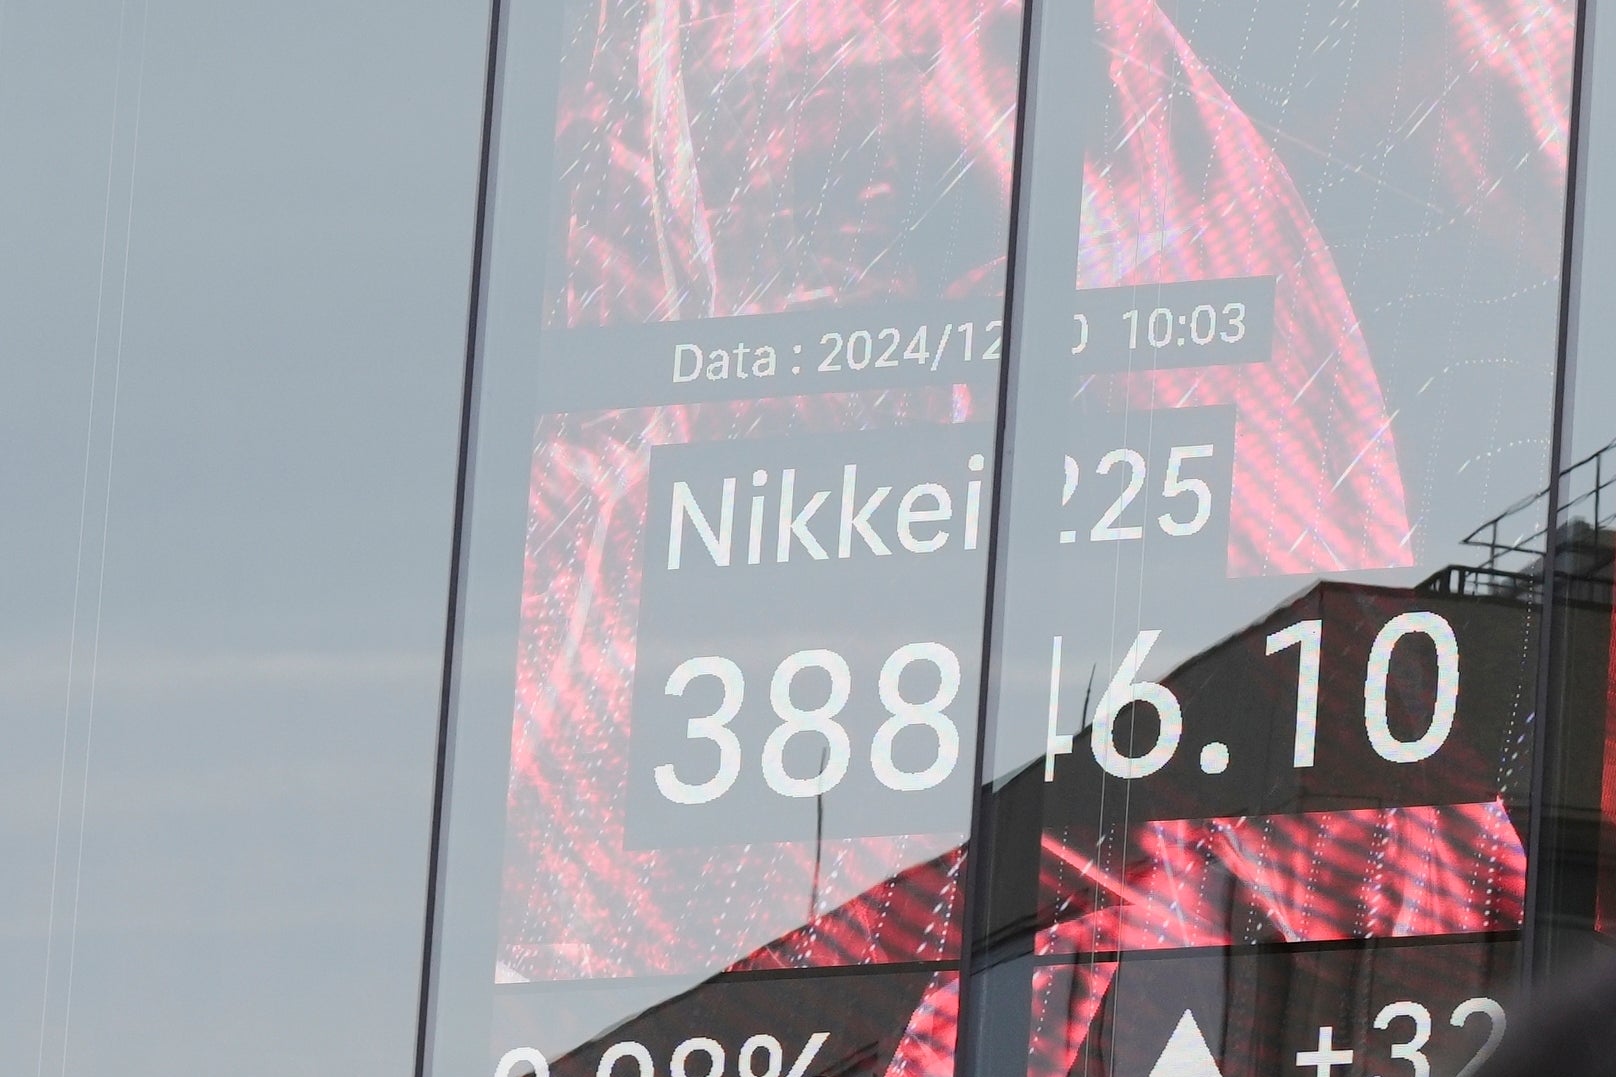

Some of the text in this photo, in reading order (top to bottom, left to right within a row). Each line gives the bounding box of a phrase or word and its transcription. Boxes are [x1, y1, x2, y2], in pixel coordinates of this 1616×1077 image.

[672, 340, 777, 383] Data
[1122, 301, 1248, 351] 10:03
[667, 453, 985, 571] Nikkei
